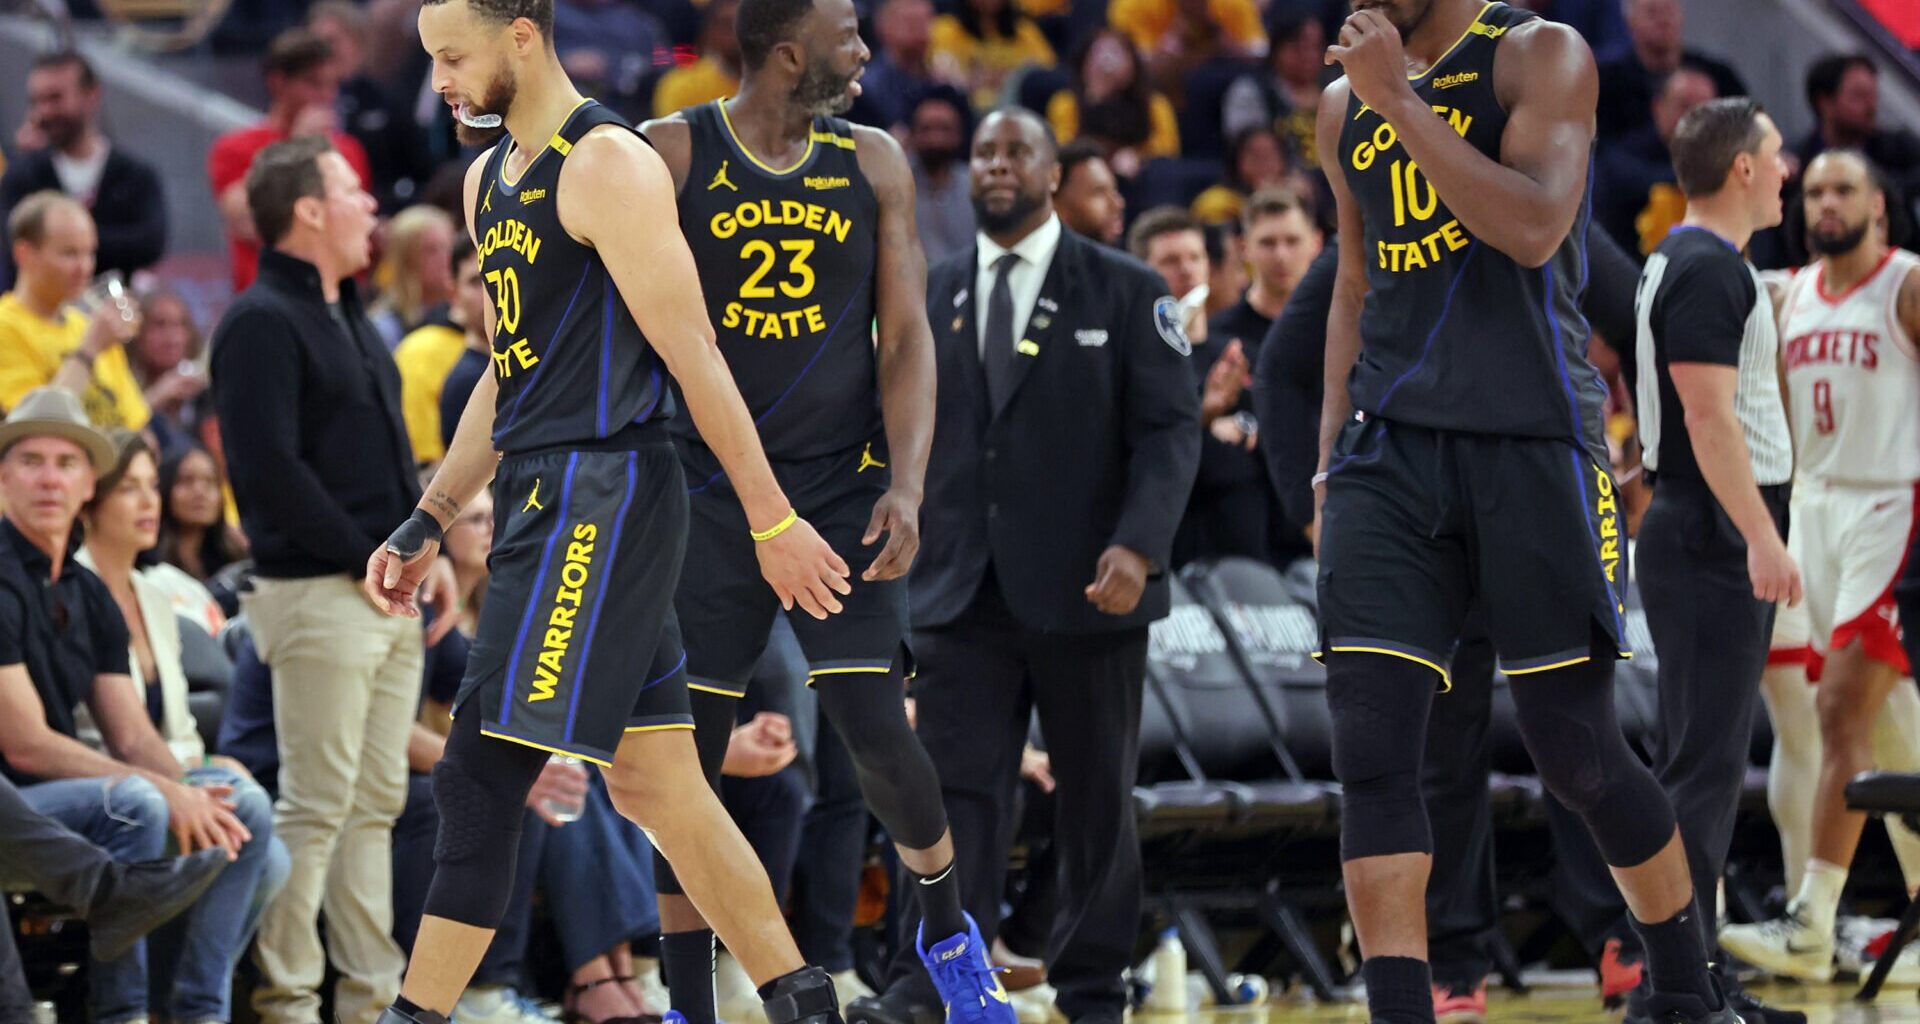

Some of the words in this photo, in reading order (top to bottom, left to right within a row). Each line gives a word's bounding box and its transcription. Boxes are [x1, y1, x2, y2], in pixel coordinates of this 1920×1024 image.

[1433, 72, 1478, 89] Rakuten
[1352, 105, 1472, 170] GON
[519, 188, 546, 205] Rakuten
[803, 176, 850, 190] Rakuten
[1390, 160, 1437, 226] 10
[477, 219, 541, 272] GOLDEN
[710, 200, 852, 243] GOLDEN
[1378, 219, 1469, 273] STATE
[739, 239, 815, 298] 23
[722, 302, 826, 339] STATE
[1813, 379, 1835, 436] 9
[528, 523, 598, 703] WARRIORS
